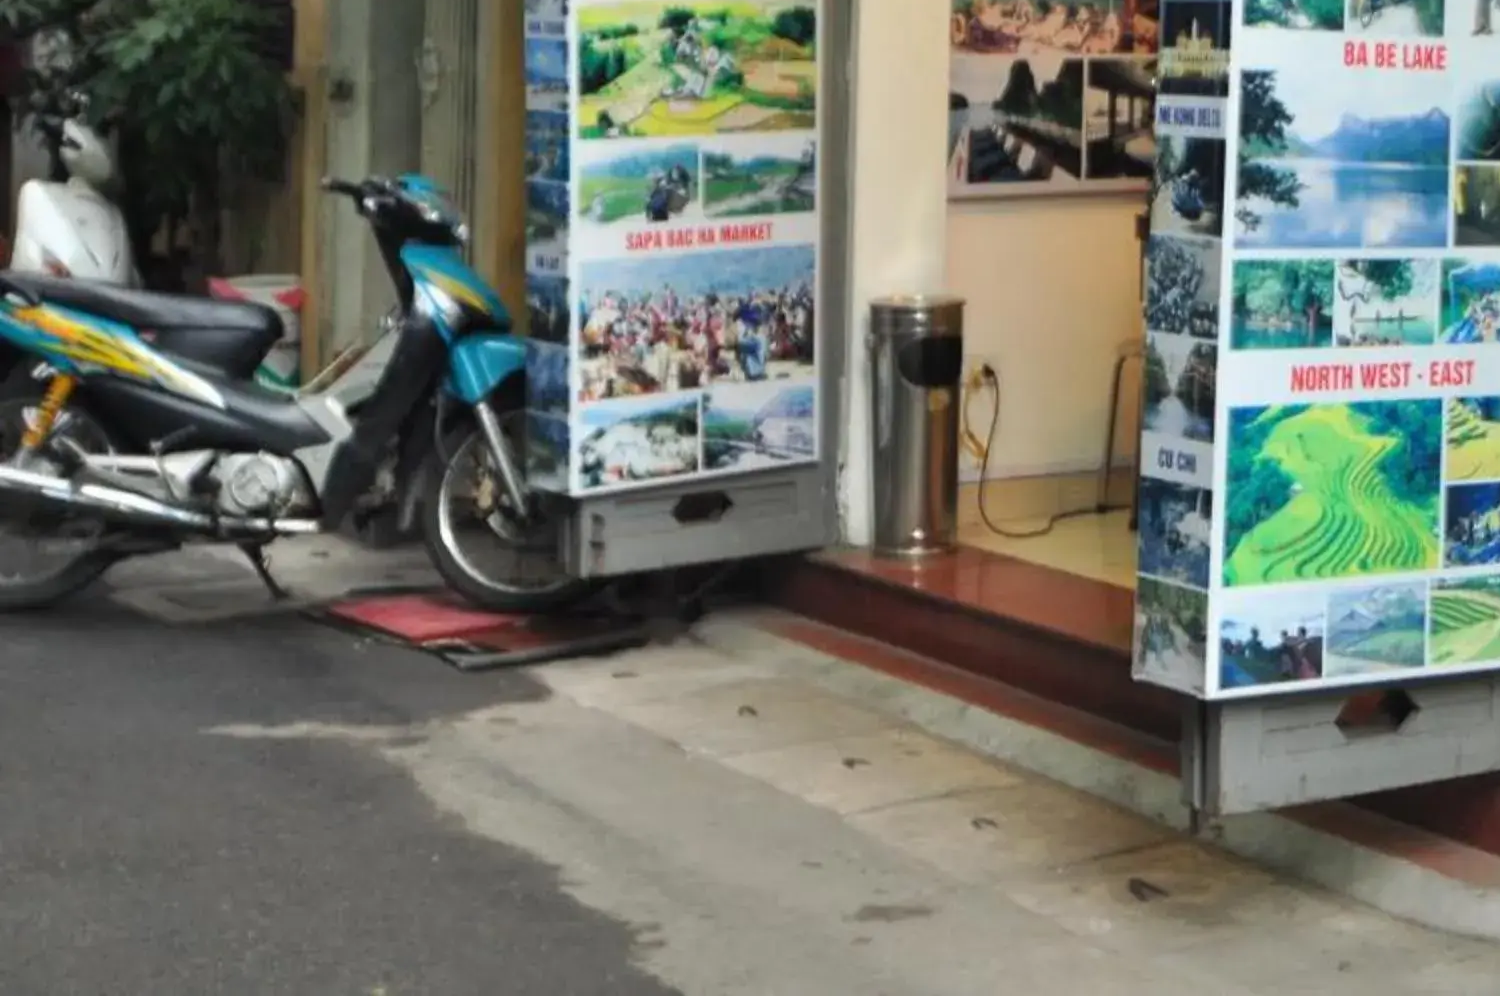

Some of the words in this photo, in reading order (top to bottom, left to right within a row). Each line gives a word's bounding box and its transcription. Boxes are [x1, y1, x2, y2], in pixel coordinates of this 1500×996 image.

[1344, 41, 1368, 67] BA
[1375, 41, 1397, 68] BE
[1403, 43, 1447, 71] LAKE
[625, 230, 662, 251] SAPA
[666, 227, 692, 247] BAC
[720, 222, 773, 243] MARKET
[1290, 364, 1353, 392] NORTH
[1360, 362, 1412, 387] WEST
[1429, 360, 1475, 386] EAST
[1158, 446, 1173, 469] CU
